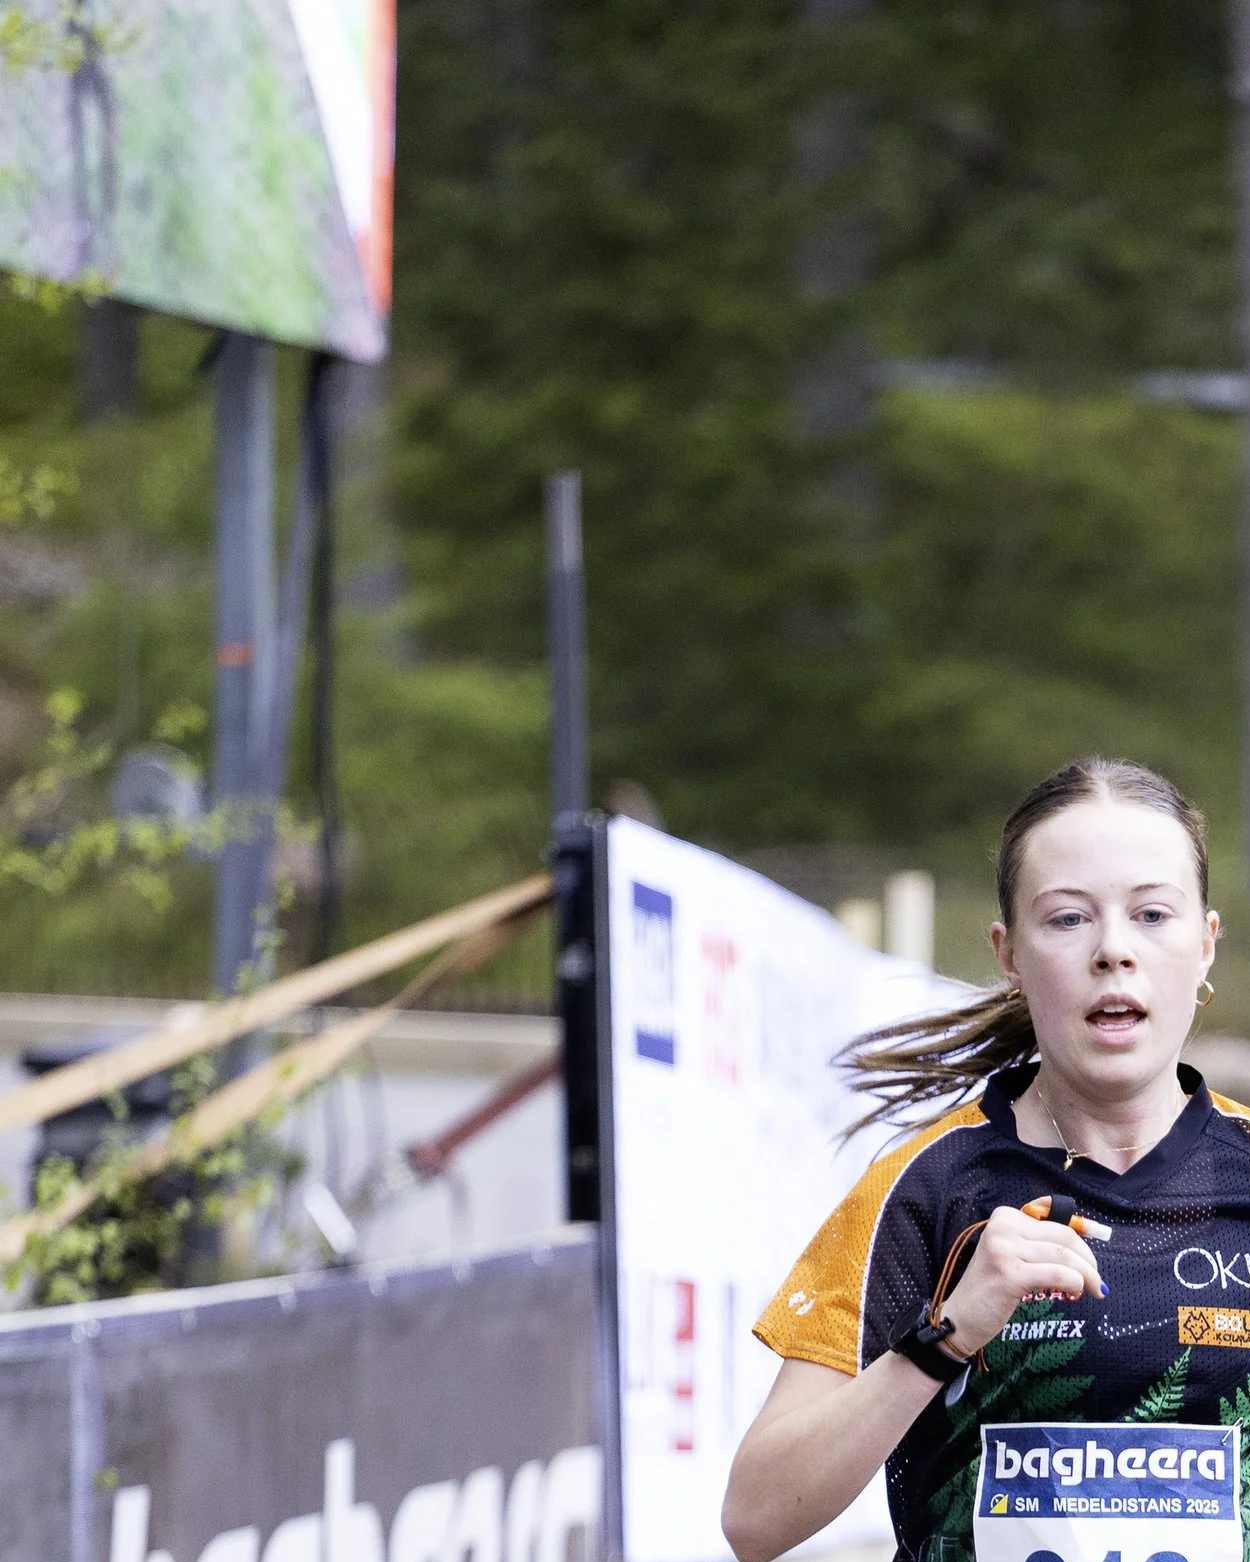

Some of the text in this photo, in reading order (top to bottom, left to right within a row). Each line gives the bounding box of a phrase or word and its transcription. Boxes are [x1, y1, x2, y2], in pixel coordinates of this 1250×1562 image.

[1001, 1320, 1085, 1342] TRIMTEX
[995, 1440, 1226, 1486] bagheera
[1015, 1498, 1220, 1514] SM MEDELDISTANS 2025
